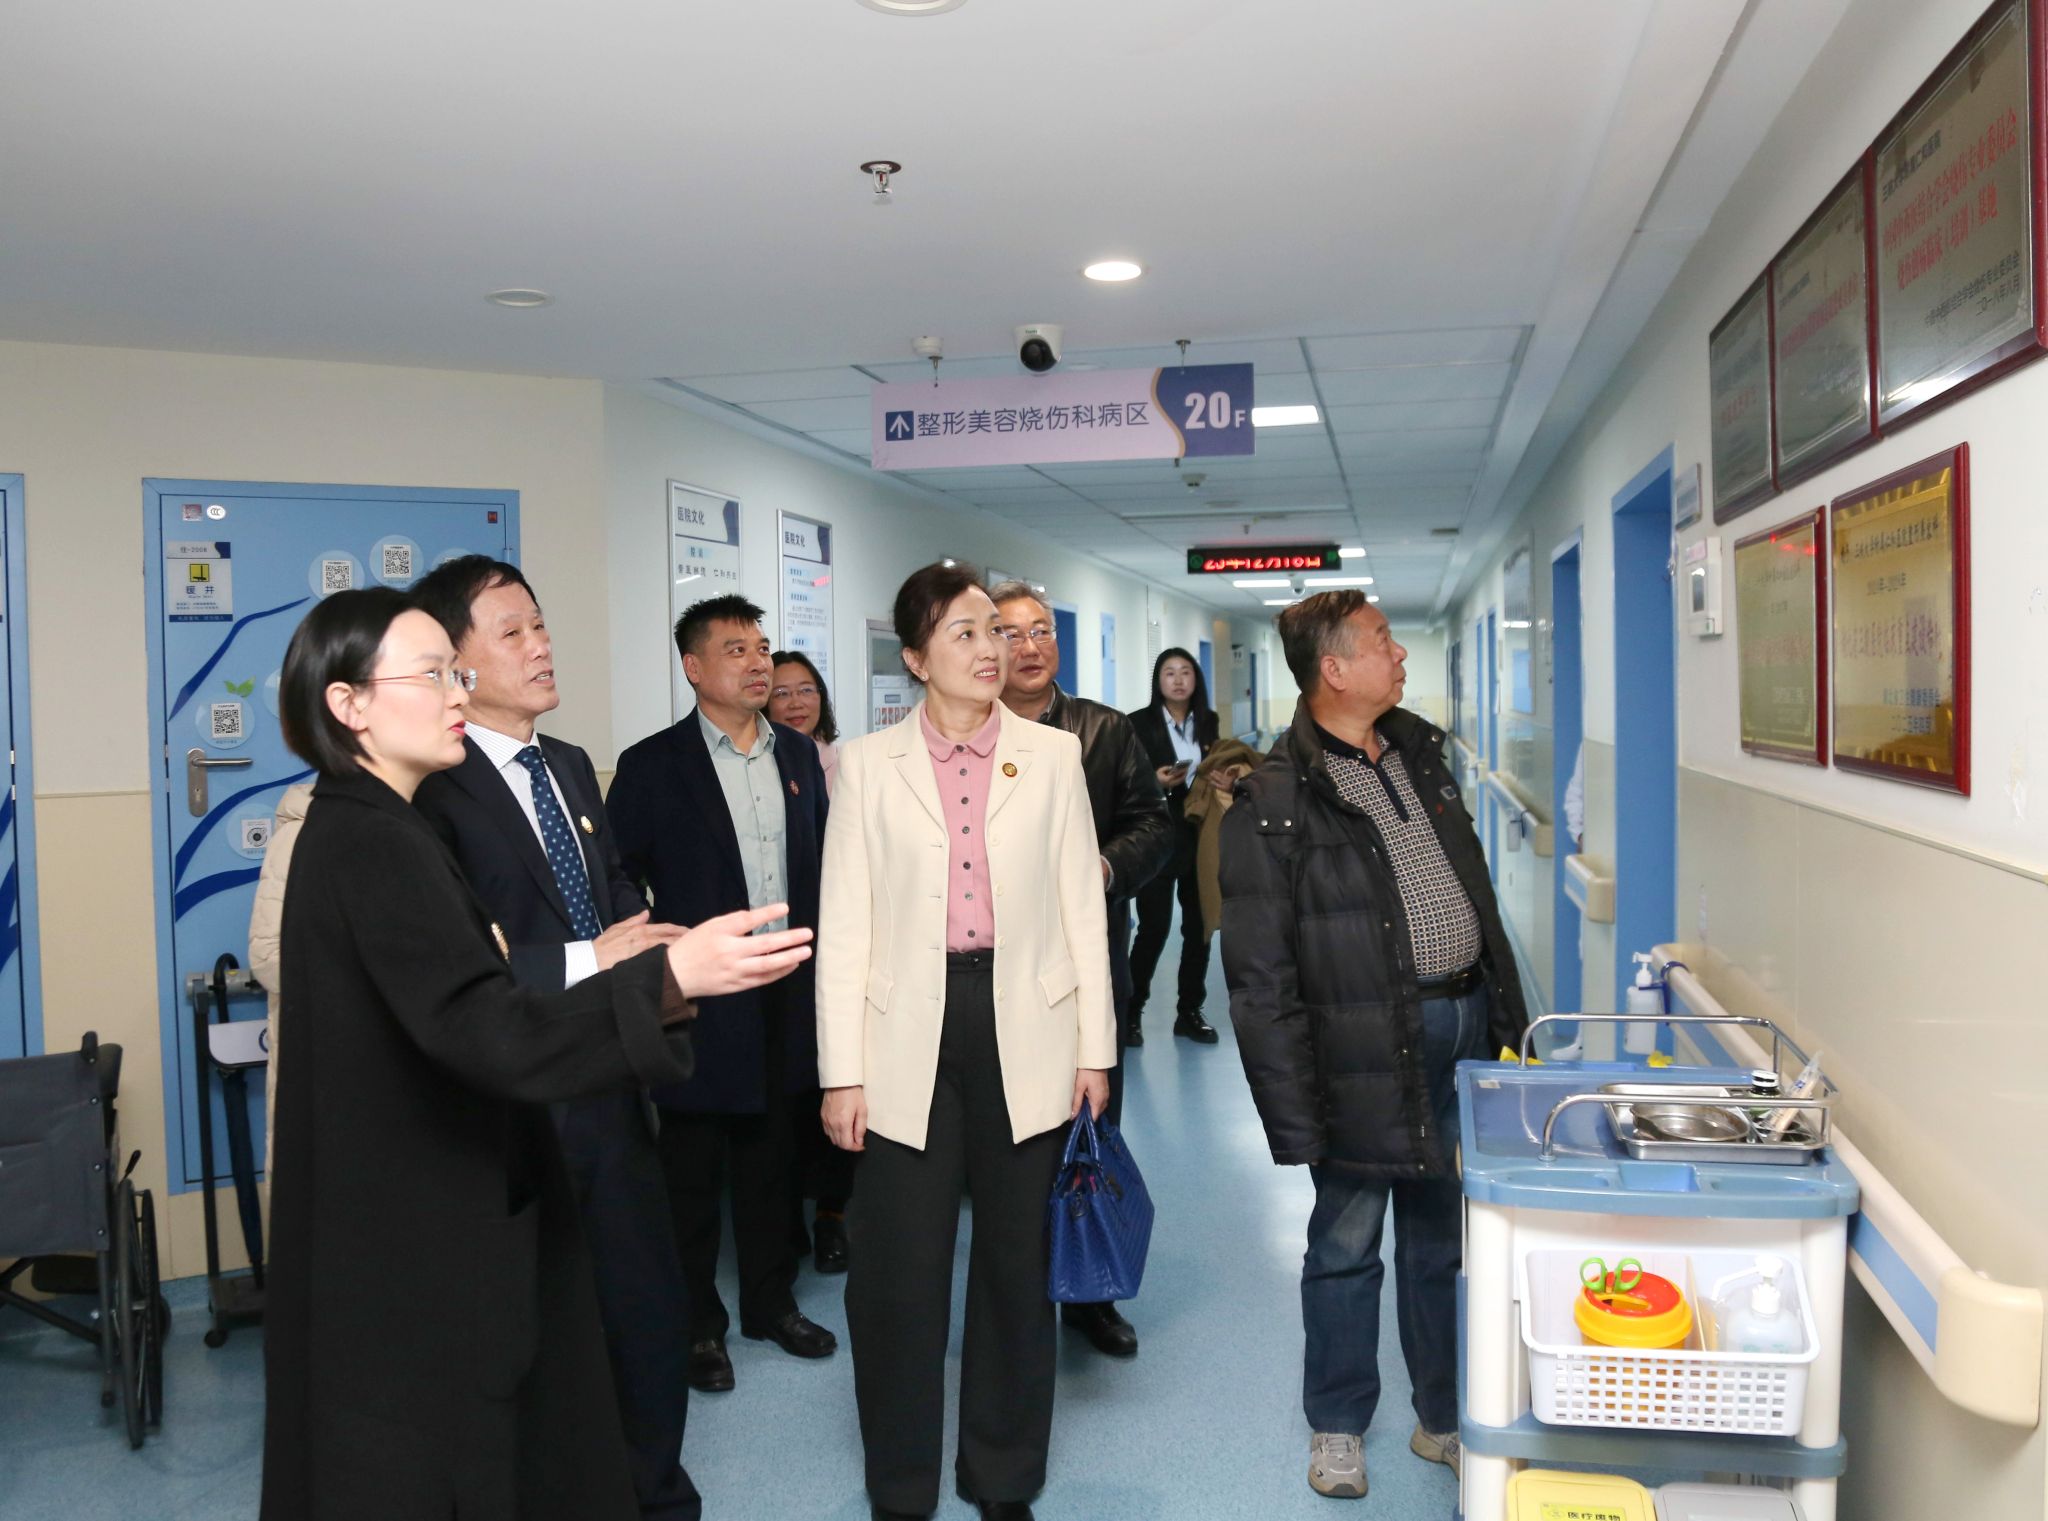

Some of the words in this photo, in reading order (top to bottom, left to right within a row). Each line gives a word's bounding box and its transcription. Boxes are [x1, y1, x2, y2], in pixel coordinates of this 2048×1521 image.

[917, 401, 1150, 437] 整形美容烧伤科病区
[677, 506, 705, 525] 医院文化
